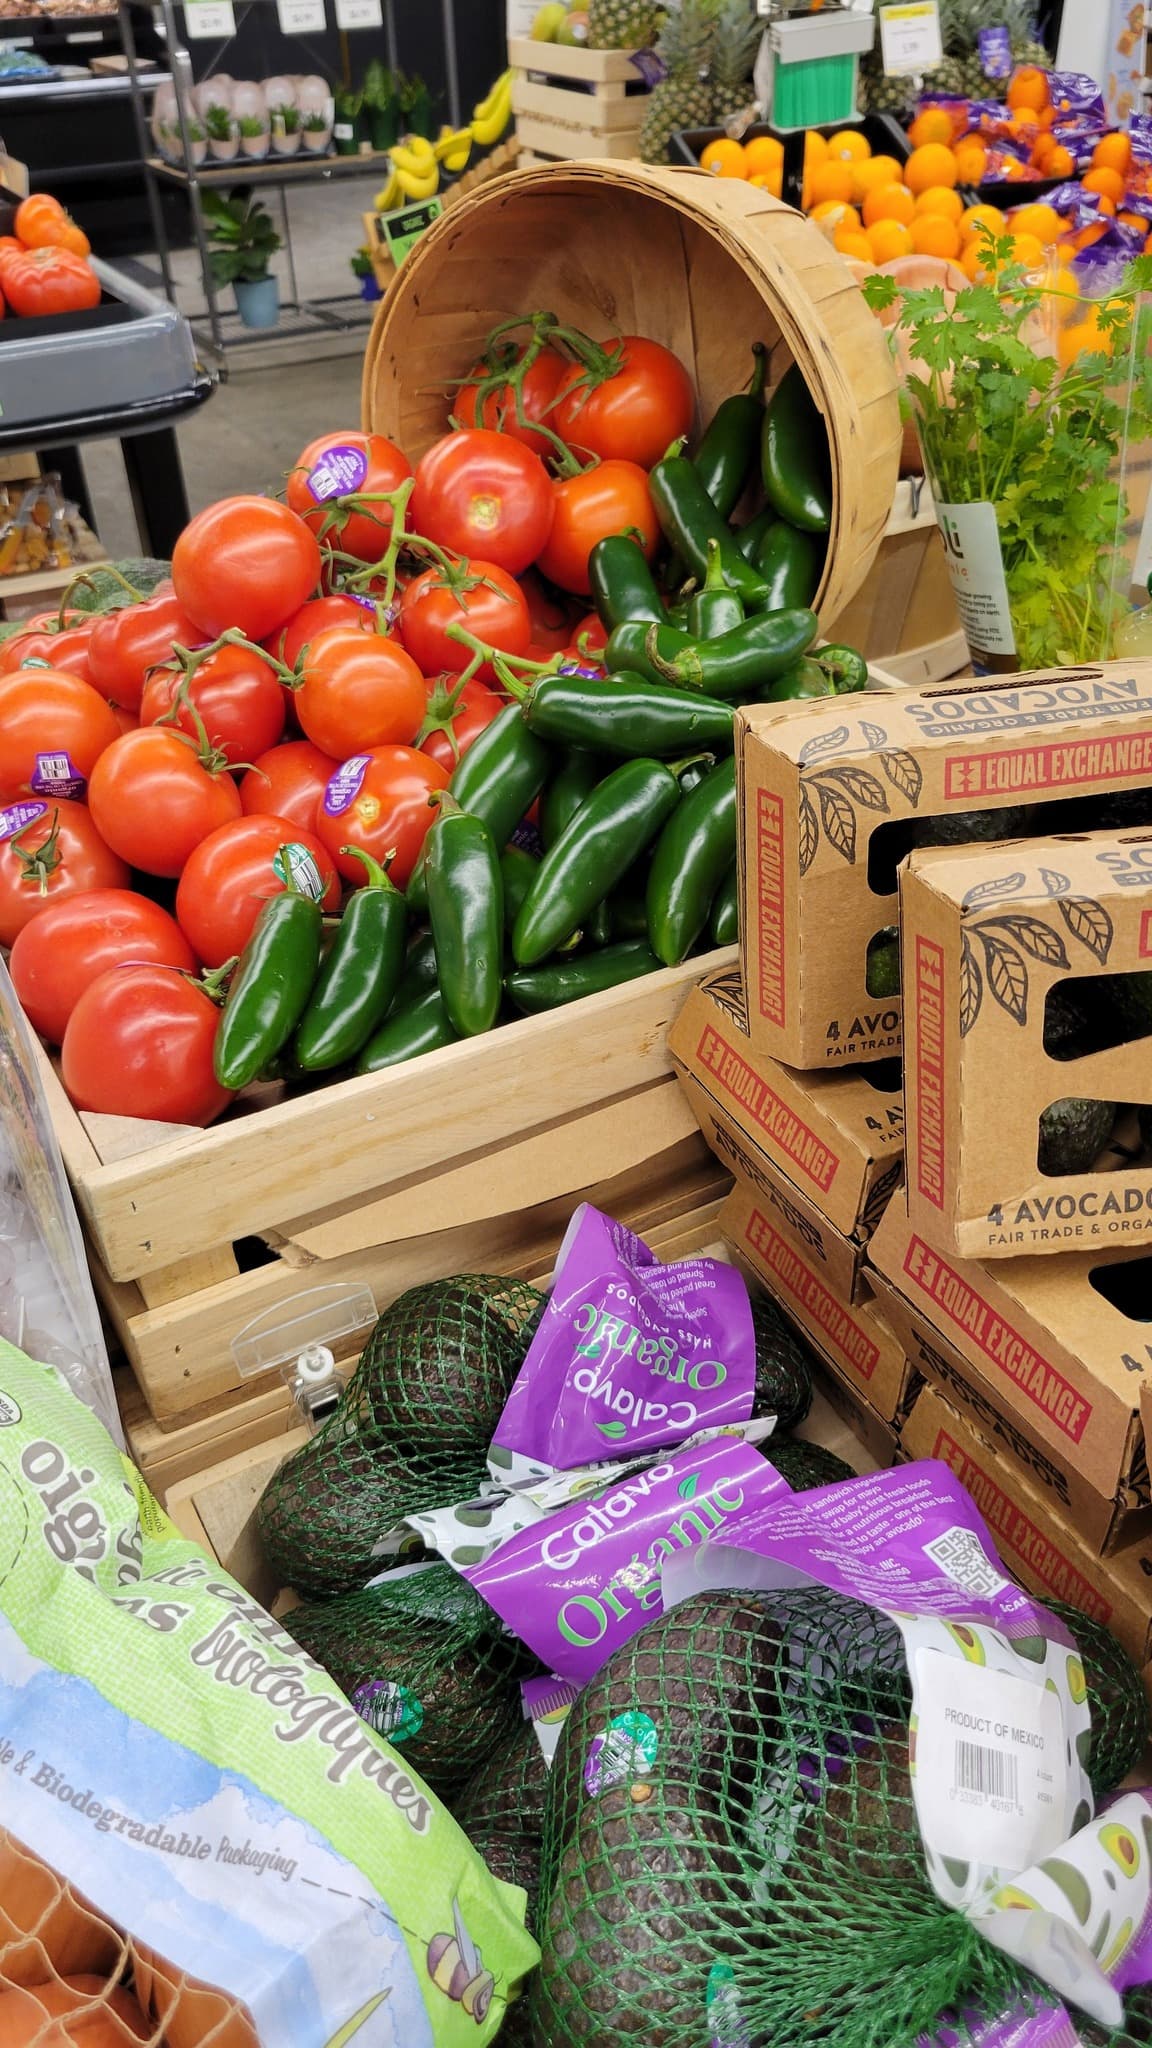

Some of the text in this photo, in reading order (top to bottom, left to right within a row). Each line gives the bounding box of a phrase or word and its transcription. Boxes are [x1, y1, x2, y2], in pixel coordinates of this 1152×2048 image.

[903, 678, 1139, 723] AVOCADOS
[931, 699, 1151, 736] FAIR TRADE & ORGANIC
[986, 735, 1152, 790] EQUAL EXCHANGE
[760, 835, 783, 1025] EQUAL EXCHANGE
[826, 1021, 840, 1042] 4
[826, 1034, 903, 1057] FAIR TRADE
[720, 1052, 758, 1112] EQUAL
[757, 1092, 835, 1187] EXCHANGE
[918, 987, 944, 1208] EQUAL EXCHANGE
[865, 1116, 882, 1131] 4
[987, 1188, 1152, 1226] 4 AVOCADO
[988, 1218, 1152, 1246] FAIR TRADE & ORGA
[677, 1271, 705, 1283] Spread
[692, 1280, 716, 1292] Great
[769, 1240, 877, 1375] EQUAL EXCHANGE
[573, 1302, 727, 1391] Organic
[678, 1328, 712, 1350] HASS
[935, 1270, 985, 1340] EQUAL
[986, 1323, 1086, 1438] EXCHANGE
[1120, 1353, 1144, 1372] 4
[573, 1367, 698, 1430] Calavo
[541, 1463, 675, 1571] Calavo
[812, 1486, 854, 1511] sandwich
[820, 1503, 847, 1521] swap
[844, 1496, 858, 1508] for
[858, 1485, 882, 1502] mayo
[831, 1519, 840, 1530] of
[840, 1504, 868, 1526] baby's
[867, 1494, 885, 1510] first
[884, 1485, 907, 1501] fresh
[907, 1478, 932, 1491] foods
[853, 1505, 894, 1532] nutritious
[894, 1489, 933, 1508] breakfast
[858, 1534, 869, 1545] to
[867, 1519, 891, 1538] taste
[894, 1509, 911, 1521] one
[912, 1503, 922, 1514] of
[920, 1497, 937, 1510] the
[965, 1467, 1014, 1533] EQUAL
[873, 1535, 888, 1547] an
[886, 1513, 926, 1540] avocado!
[556, 1476, 745, 1648] Organic
[190, 1611, 431, 1832] biologiques
[944, 1707, 1045, 1751] PRODUCT OF MEXICO
[14, 1749, 36, 1776] &
[30, 1761, 212, 1860] Biodegradable
[215, 1835, 298, 1882] Packaging
